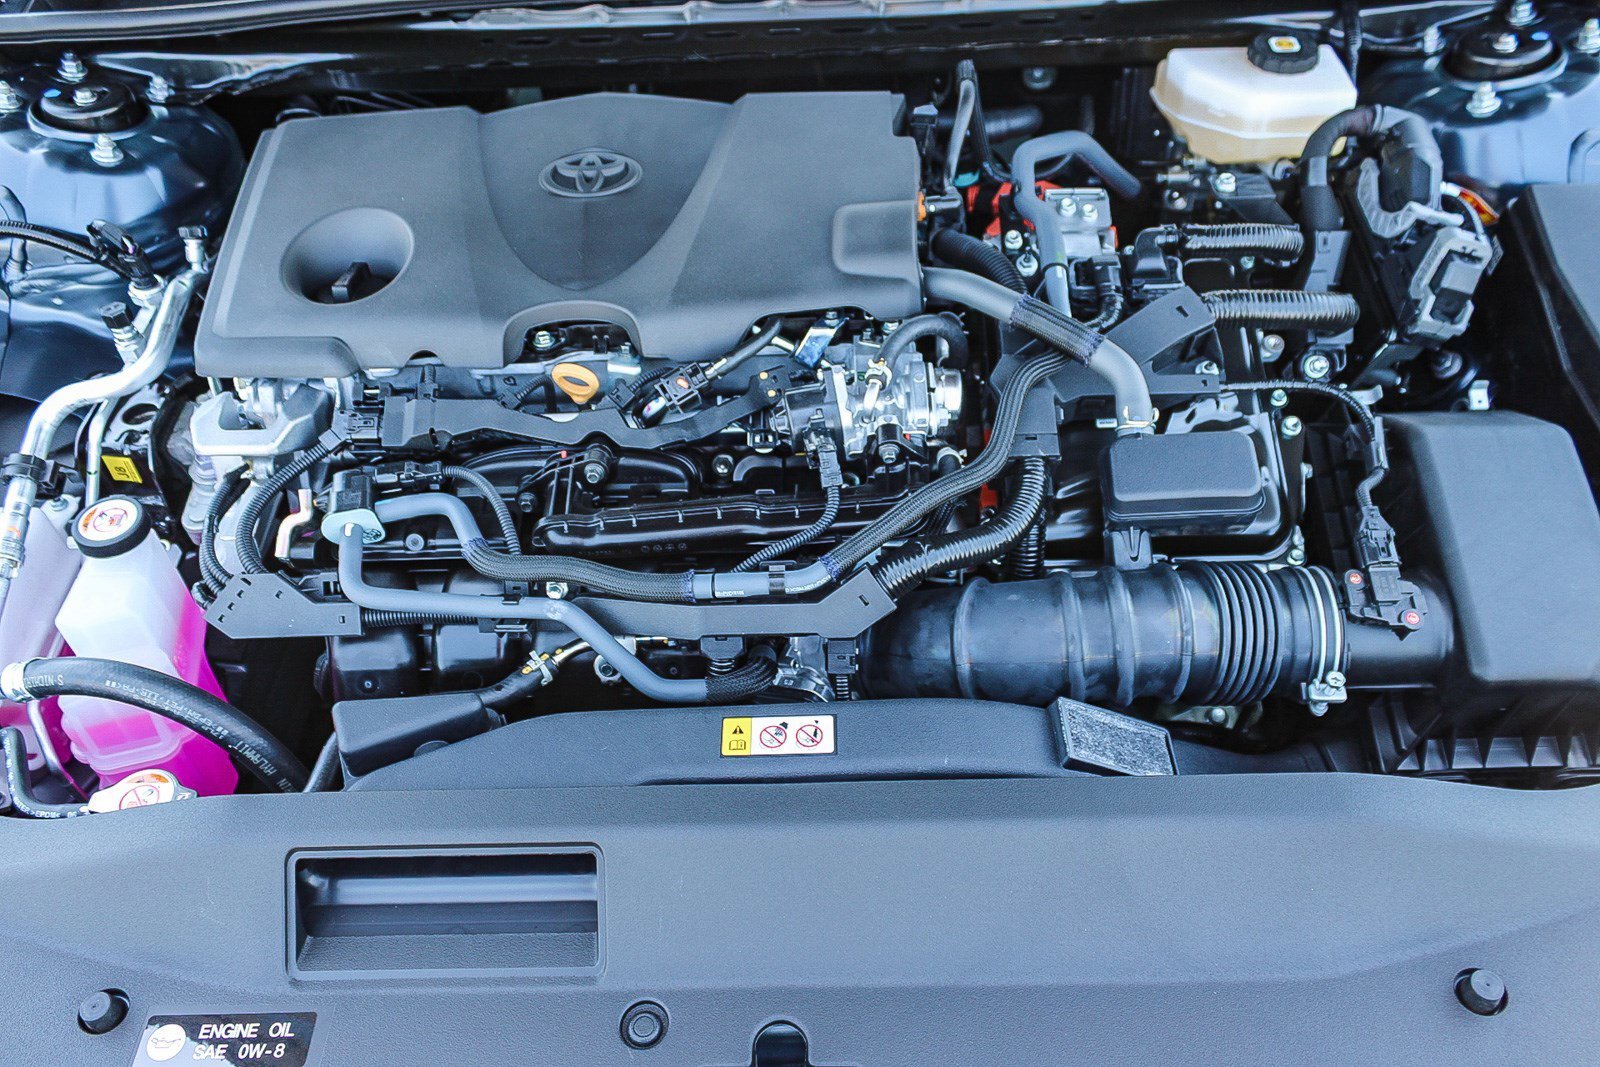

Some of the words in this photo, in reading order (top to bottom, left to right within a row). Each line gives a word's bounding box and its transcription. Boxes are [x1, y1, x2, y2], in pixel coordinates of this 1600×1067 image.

[198, 1023, 260, 1039] ENGINE
[268, 1022, 296, 1038] OIL
[192, 1044, 229, 1060] SAE
[238, 1043, 287, 1059] 0W-8
